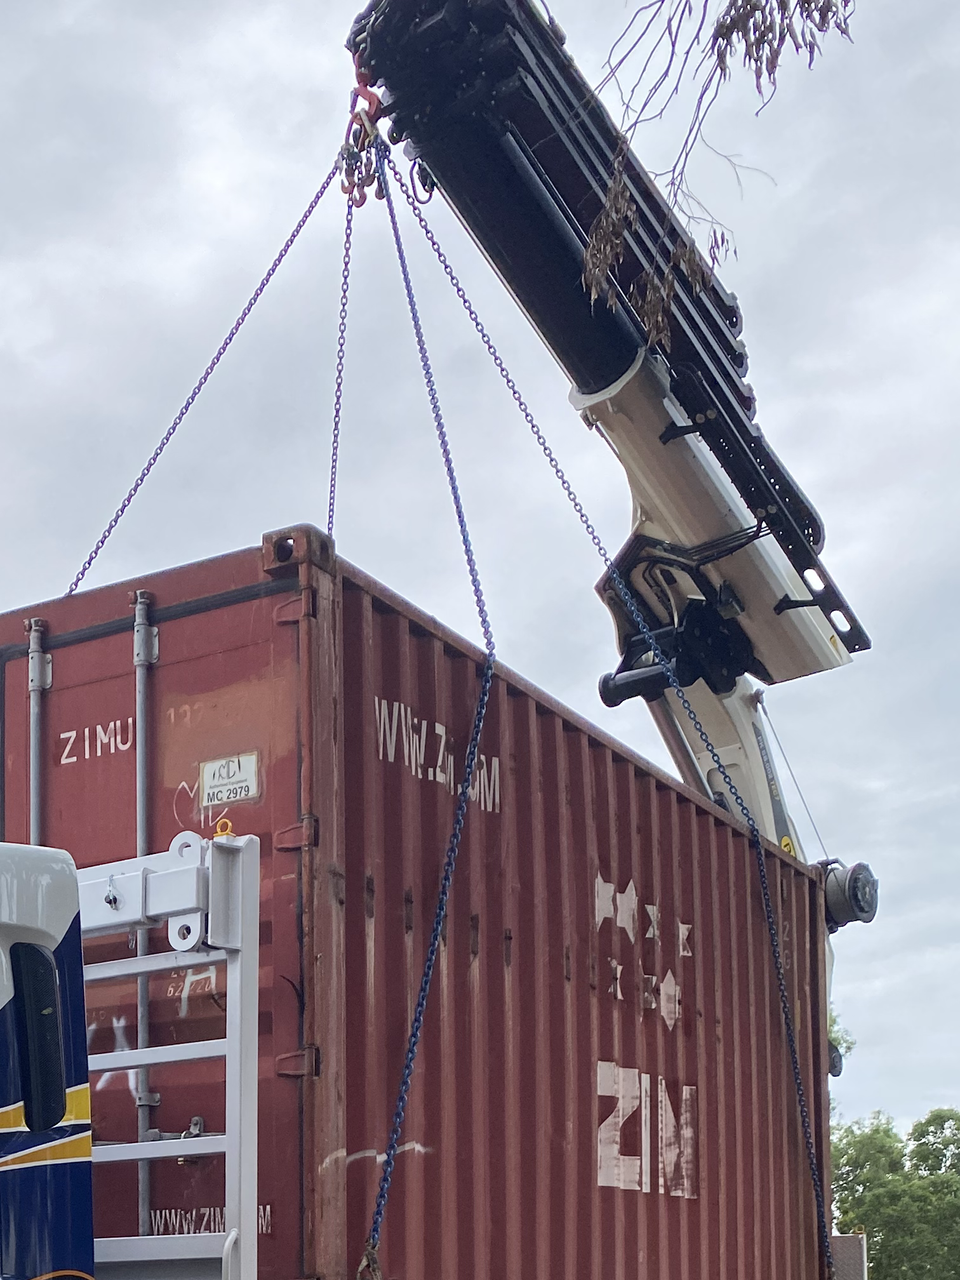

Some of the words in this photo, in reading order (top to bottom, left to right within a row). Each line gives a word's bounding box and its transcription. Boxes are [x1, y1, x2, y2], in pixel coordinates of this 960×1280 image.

[60, 717, 133, 764] ZIMU
[207, 790, 223, 803] MC
[226, 785, 250, 800] 2979
